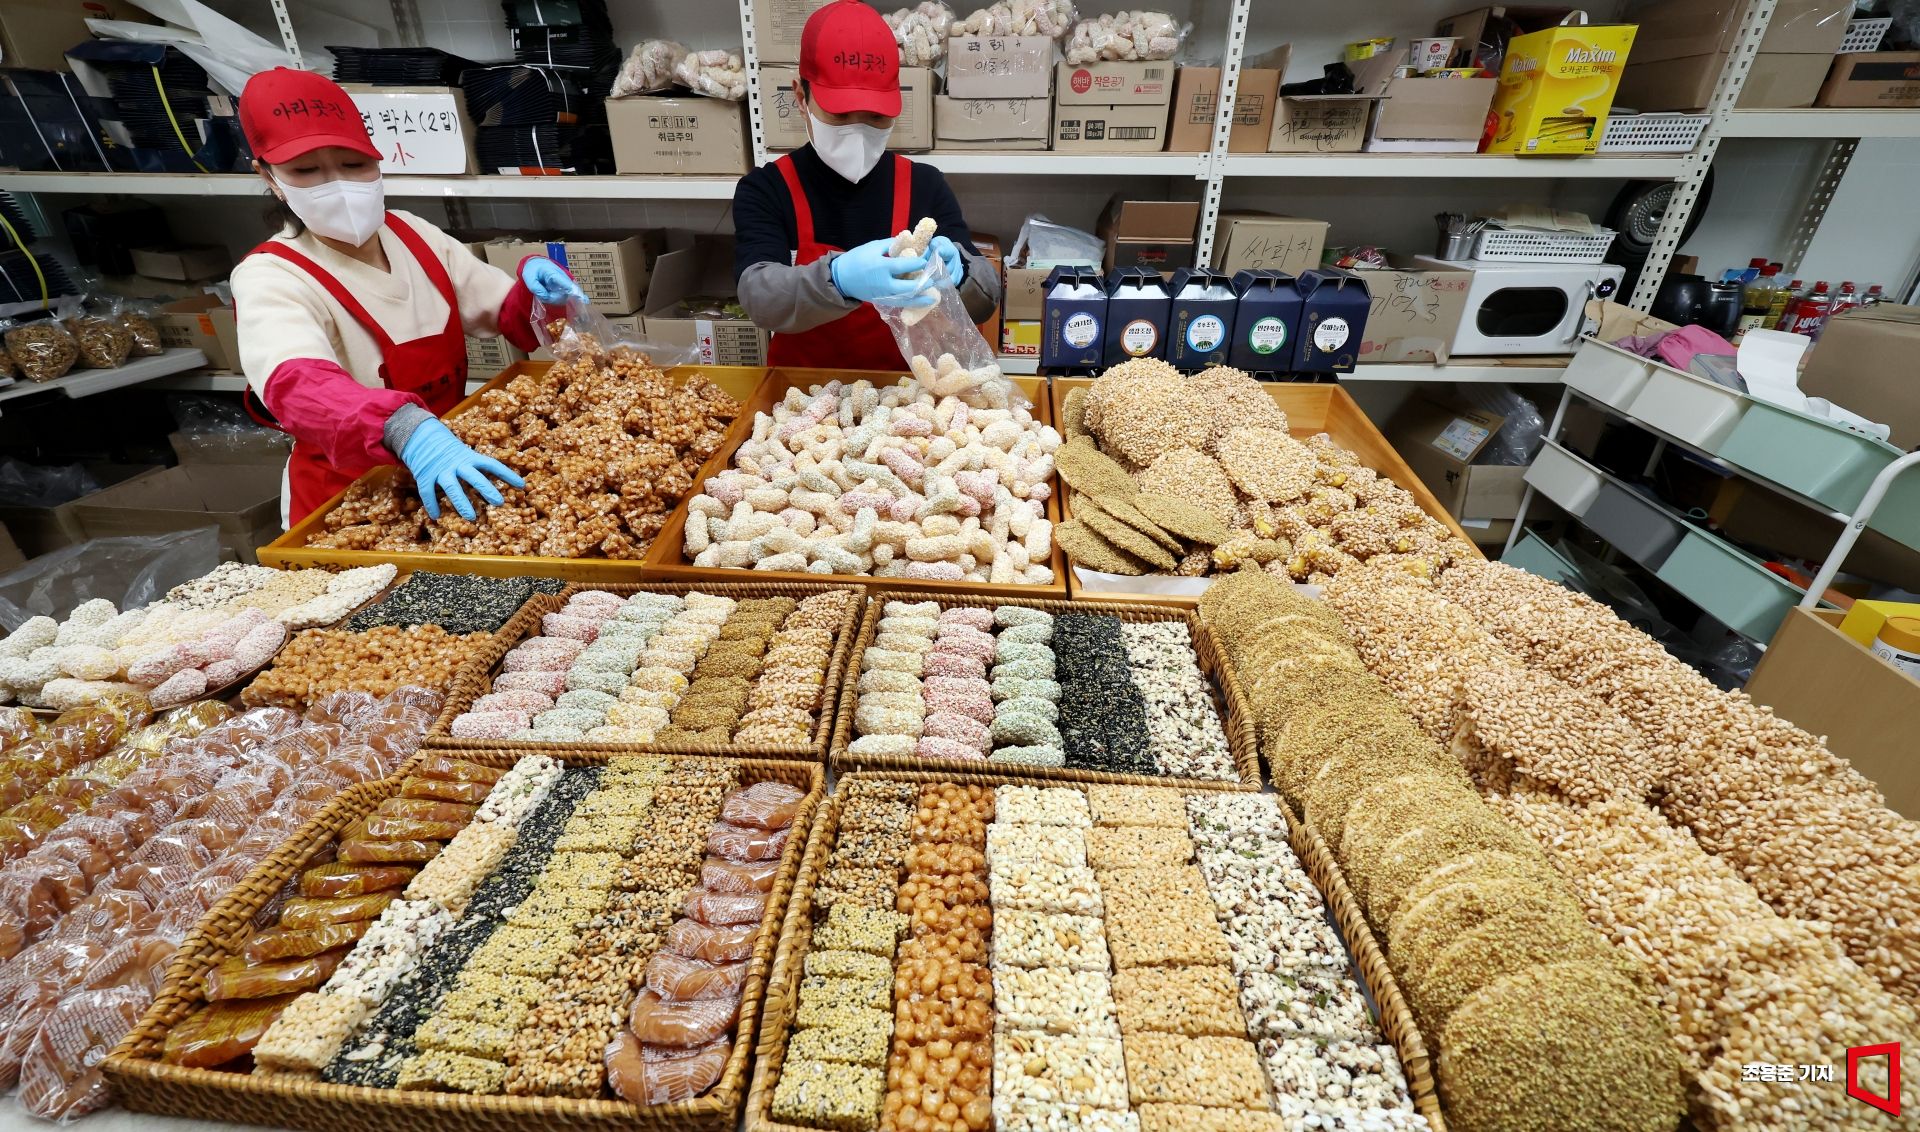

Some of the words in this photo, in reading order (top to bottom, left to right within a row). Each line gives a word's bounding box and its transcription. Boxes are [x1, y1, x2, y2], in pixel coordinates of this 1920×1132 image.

[1565, 43, 1616, 63] Maxim
[833, 51, 887, 74] 아리곳간
[1592, 65, 1613, 73] 마일드
[1072, 76, 1090, 88] 햇반
[1094, 76, 1125, 88] 작은공기
[273, 99, 346, 122] 아리곳간
[658, 132, 694, 142] 취급주의
[1241, 234, 1314, 269] 쌍화차
